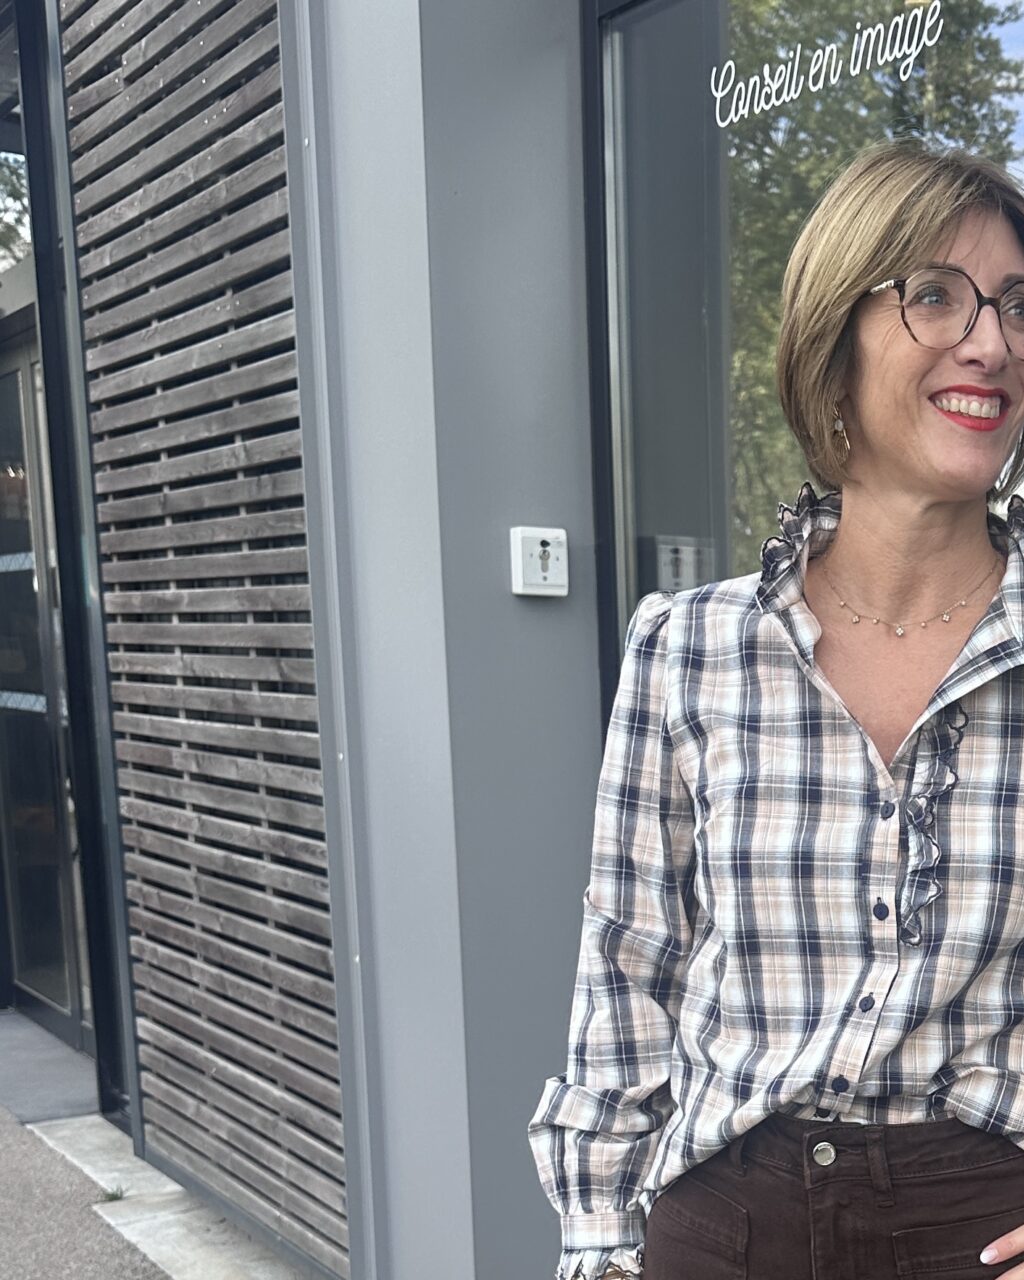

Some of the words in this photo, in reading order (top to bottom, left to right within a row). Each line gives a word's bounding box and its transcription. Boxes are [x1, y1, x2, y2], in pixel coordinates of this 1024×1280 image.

[710, 43, 804, 128] Conseil
[808, 43, 842, 92] en
[850, 0, 944, 81] image
